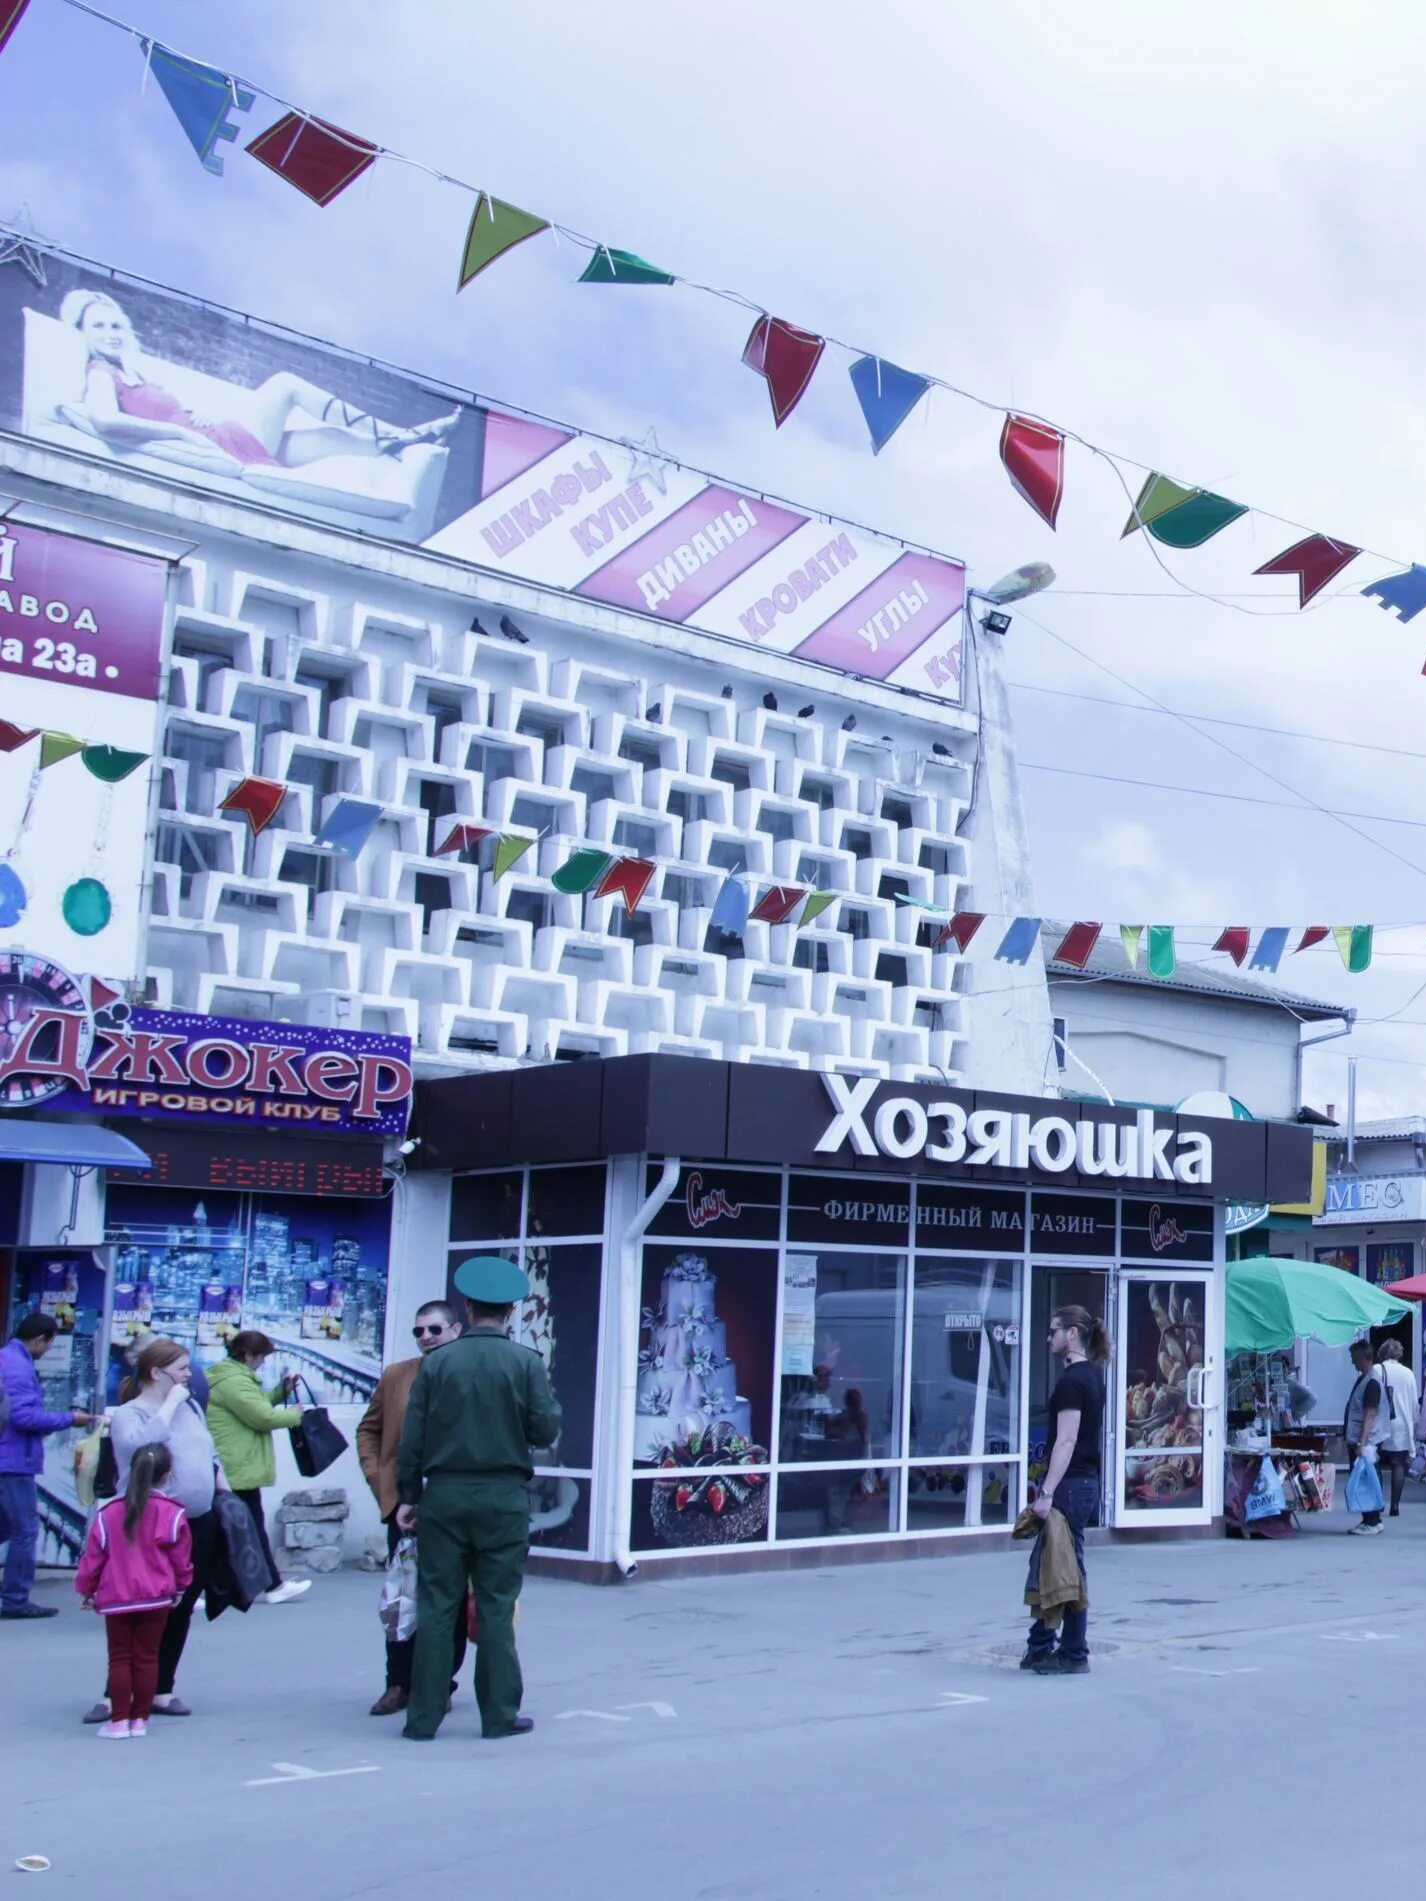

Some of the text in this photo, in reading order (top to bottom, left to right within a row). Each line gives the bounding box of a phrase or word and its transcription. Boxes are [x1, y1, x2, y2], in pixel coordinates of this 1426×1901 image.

[480, 450, 612, 559] ШКАФЫ
[569, 482, 655, 557] КУПЕ
[636, 499, 760, 611] ДИВАНЫ
[738, 532, 859, 641] КРОВАТИ
[856, 579, 930, 652] УГЛЫ
[32, 637, 97, 678] 23а
[0, 1008, 414, 1119] Джокер
[93, 1087, 342, 1123] ИГРОВОЙ КЛУБ
[813, 1072, 1214, 1184] Хозяюшка
[823, 1199, 1095, 1234] ФИРМЕННЫЙ МАГАЗИН
[945, 1314, 981, 1328] ОТКРЫТО
